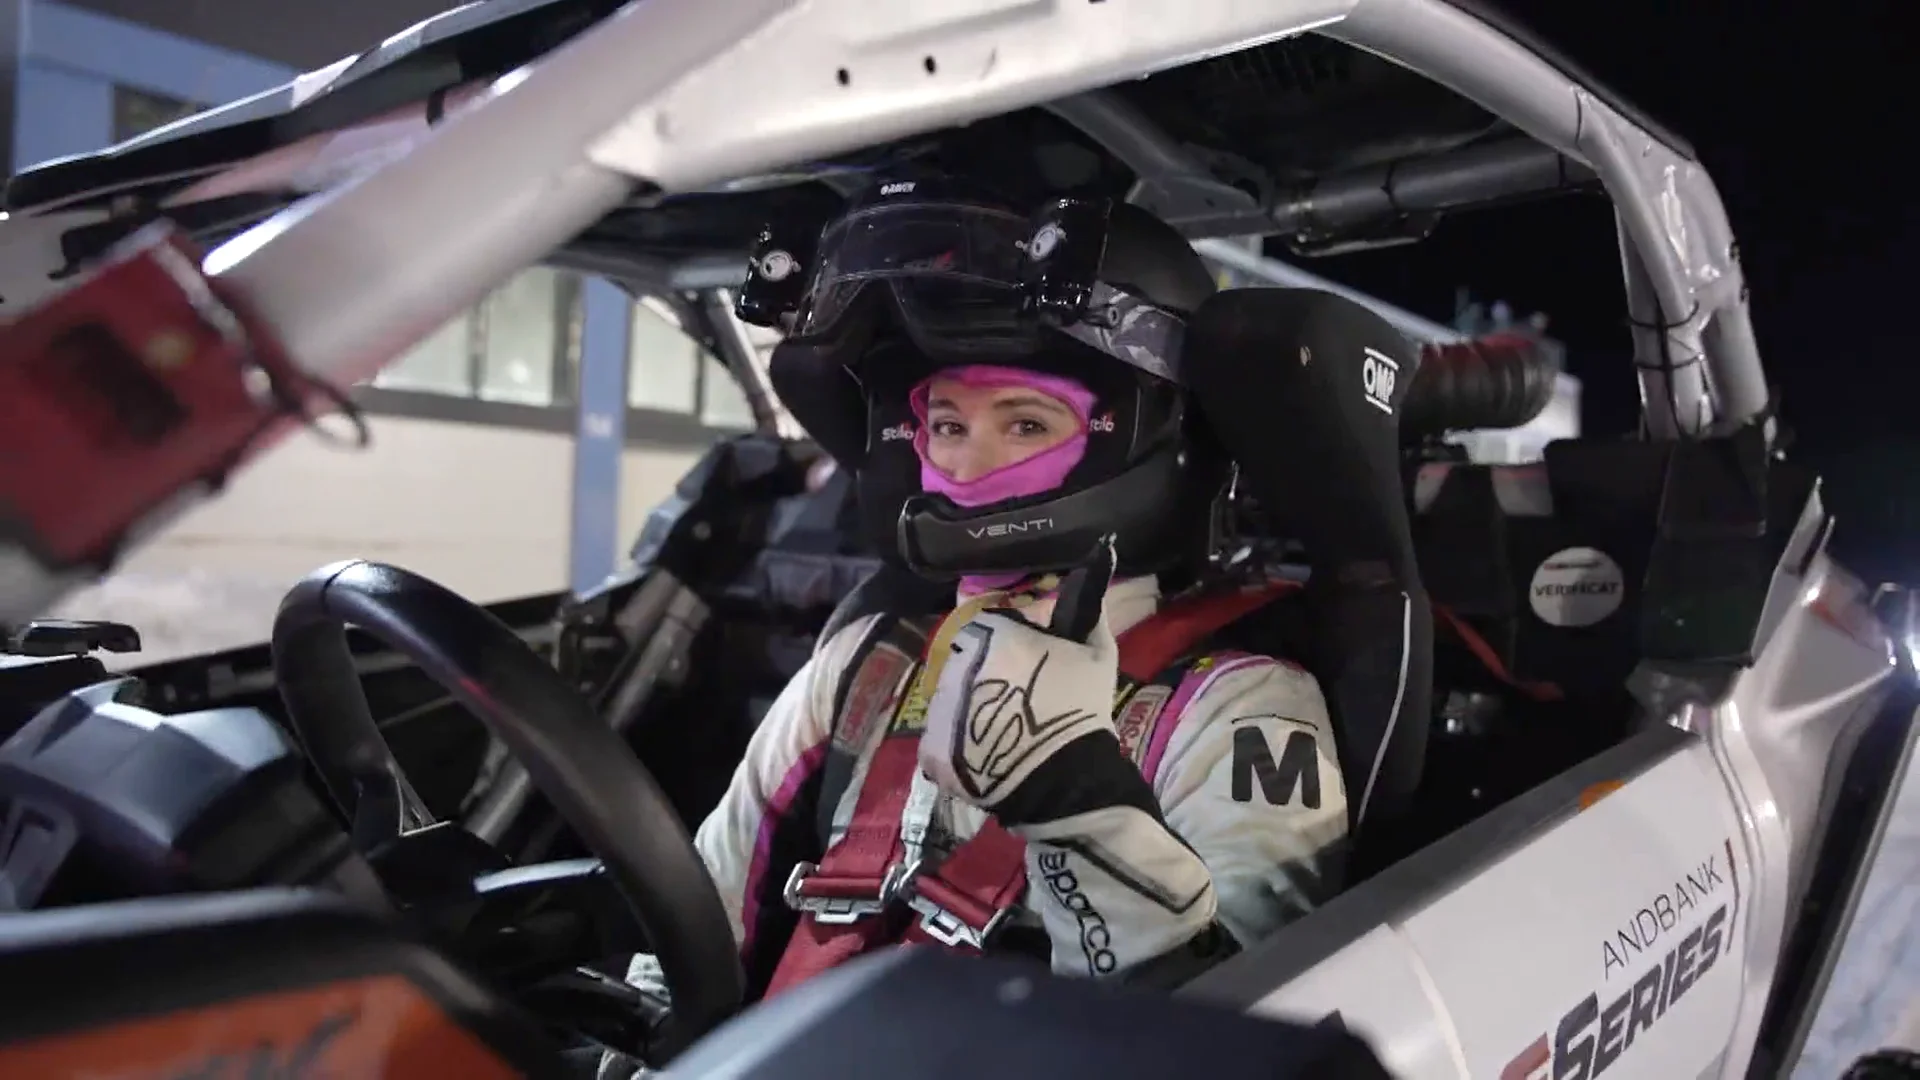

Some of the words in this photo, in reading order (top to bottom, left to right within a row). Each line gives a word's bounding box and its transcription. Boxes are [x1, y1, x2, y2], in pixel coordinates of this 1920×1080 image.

[1363, 356, 1395, 404] OMP
[966, 518, 1053, 539] VENTI
[1535, 581, 1618, 597] VERIFICAT
[1231, 726, 1321, 810] M
[1039, 851, 1117, 976] sparco
[1603, 855, 1723, 981] ANDBANK
